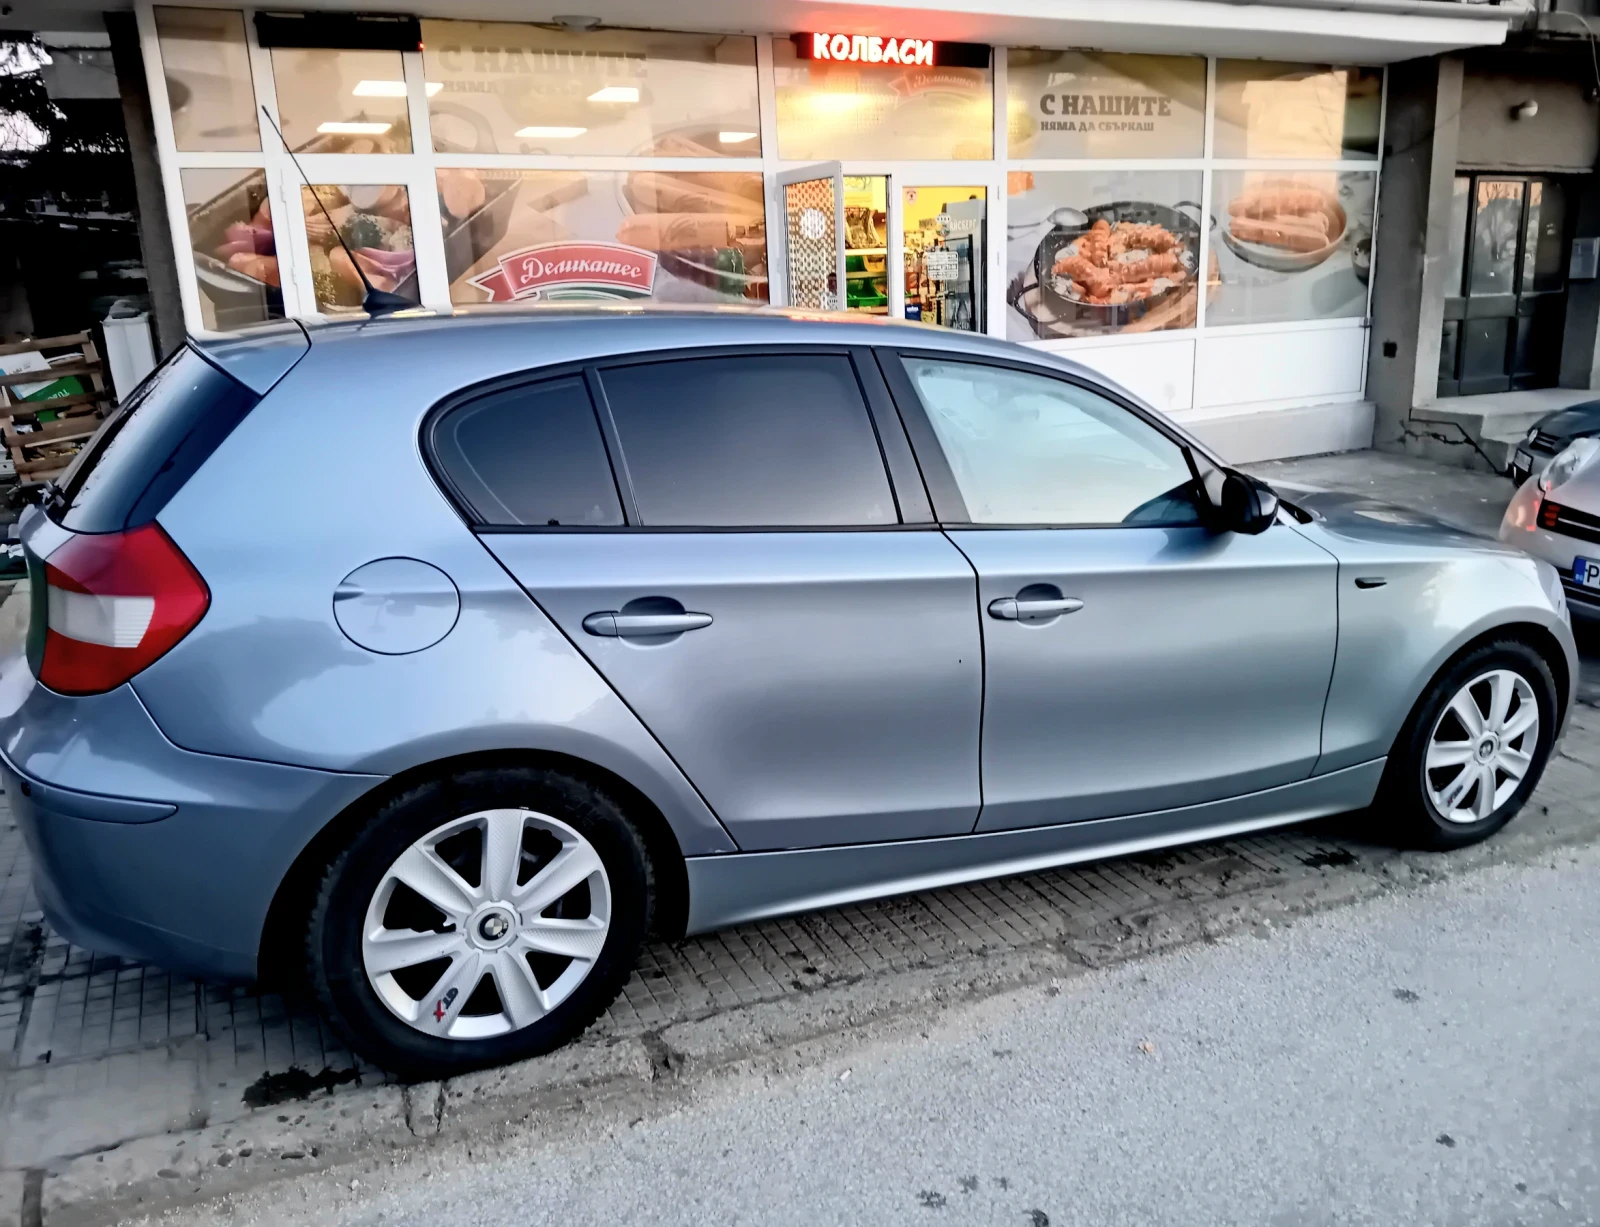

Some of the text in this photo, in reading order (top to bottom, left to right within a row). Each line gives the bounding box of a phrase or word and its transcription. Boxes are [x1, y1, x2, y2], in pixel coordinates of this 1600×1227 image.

[471, 46, 648, 77] НАШИТЕ
[813, 32, 934, 66] КОЛБАСИ
[1040, 94, 1171, 116] С НАШИТЕ
[1040, 121, 1155, 132] НЯМА ДА СБЪРКАШ
[520, 257, 643, 285] Деликатес
[1586, 564, 1600, 584] P
